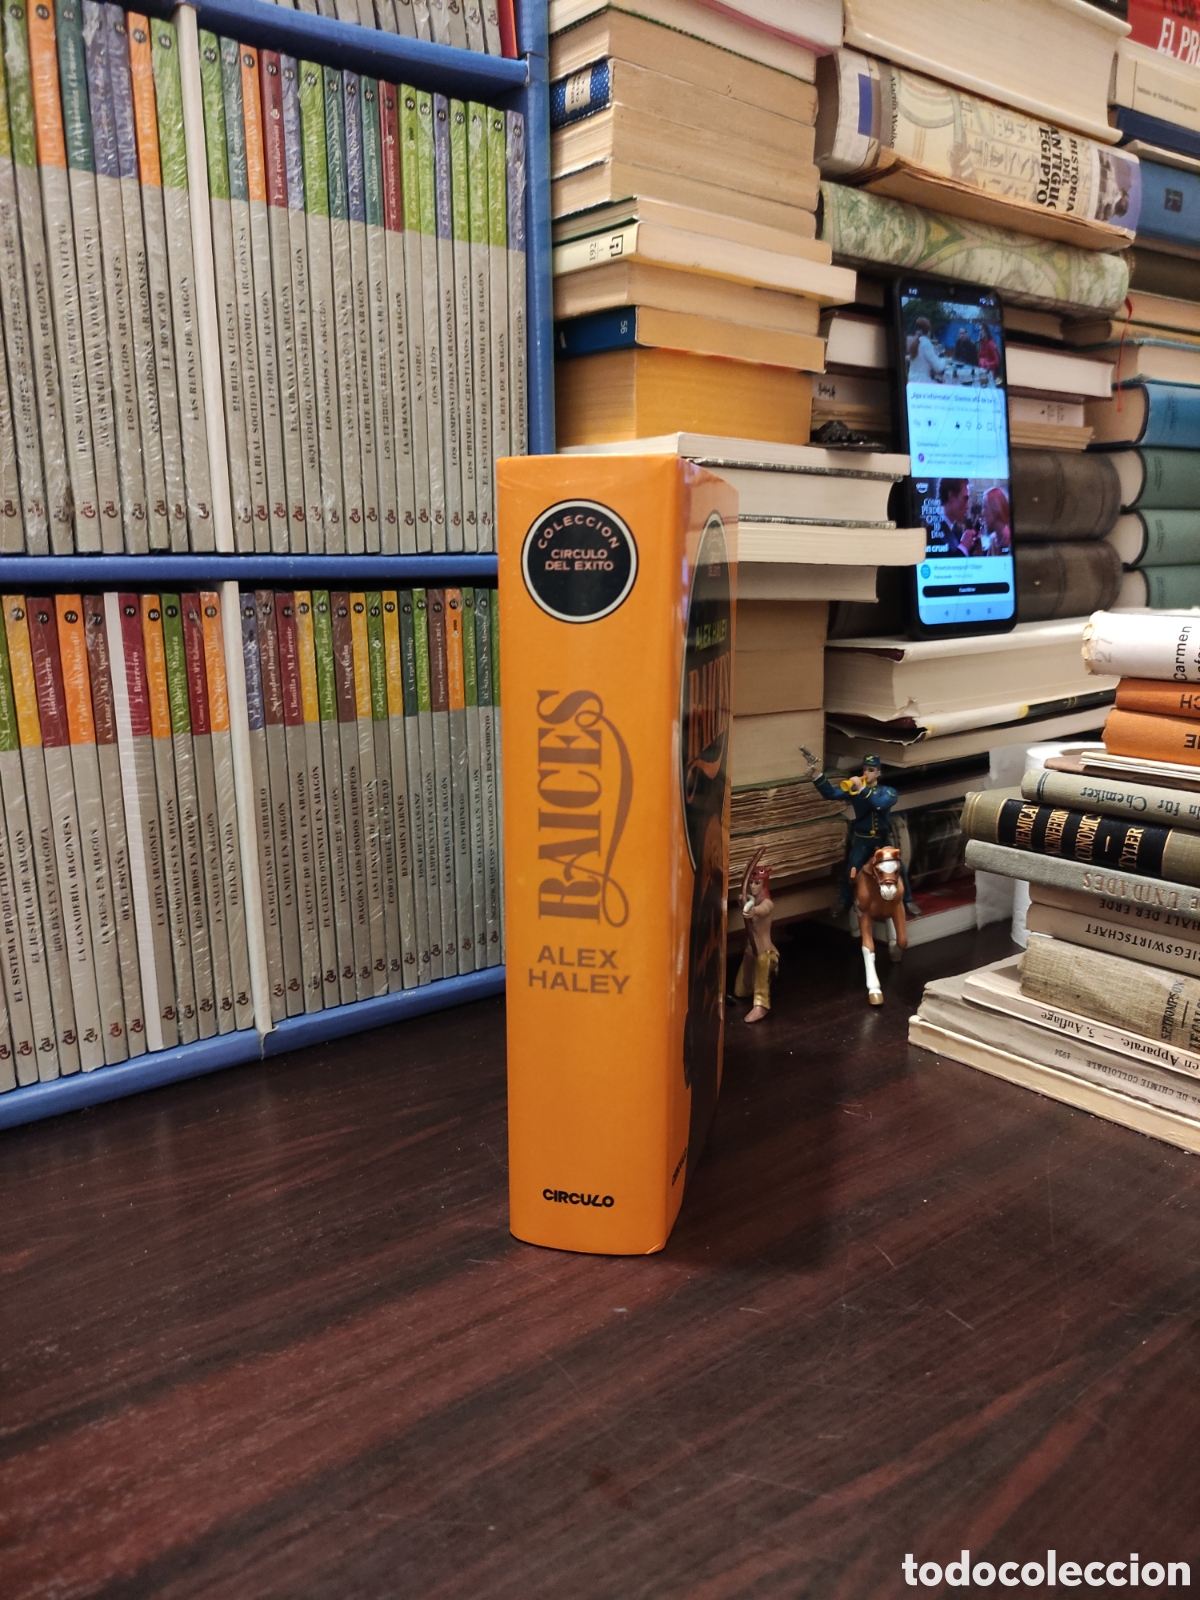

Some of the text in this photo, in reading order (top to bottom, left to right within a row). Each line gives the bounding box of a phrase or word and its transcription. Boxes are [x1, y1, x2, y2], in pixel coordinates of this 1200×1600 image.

[1157, 17, 1200, 67] EL PR
[1036, 126, 1050, 205] EGIPTO
[1060, 158, 1069, 189] DEL
[1065, 137, 1079, 213] HISTORIA
[620, 316, 628, 335] 56
[538, 514, 620, 550] COLECCION
[544, 560, 614, 571] DEL EXITO
[551, 549, 608, 560] CIRCULO
[266, 629, 277, 670] Domingo
[1173, 625, 1192, 682] Carmen
[131, 651, 143, 693] Barreiro
[348, 766, 360, 817] EUROPEOS
[1080, 786, 1148, 813] Chemiker
[312, 808, 323, 822] EN
[536, 690, 634, 928] RAICES
[1158, 800, 1181, 818] für
[62, 815, 78, 879] ARAGONESA
[262, 842, 272, 857] DE
[350, 819, 361, 857] FONDOS
[394, 794, 410, 877] BENJAMÍN JARNÉS
[1119, 827, 1145, 869] TYLER
[278, 845, 289, 858] EN
[147, 819, 166, 927] LA JOTA ARAGONESA
[264, 859, 275, 905] IGLESIAS
[280, 861, 291, 891] NIEVE
[353, 859, 363, 878] LOS
[283, 893, 293, 907] LA
[317, 875, 330, 914] CUENTO
[1083, 873, 1179, 912] UNIDADES
[1099, 898, 1131, 915] ERDE
[67, 883, 84, 945] GANADERÍA
[268, 907, 278, 927] LAS
[1136, 906, 1160, 922] DER
[7, 938, 21, 986] SISTEMA
[537, 944, 619, 969] ALEX
[13, 988, 23, 1003] EL
[527, 967, 632, 996] HALEY
[1040, 1009, 1085, 1035] Auflage
[1140, 1078, 1175, 1098] CHIMIE
[1176, 1091, 1189, 1102] DE
[542, 1188, 615, 1208] CIRCULO
